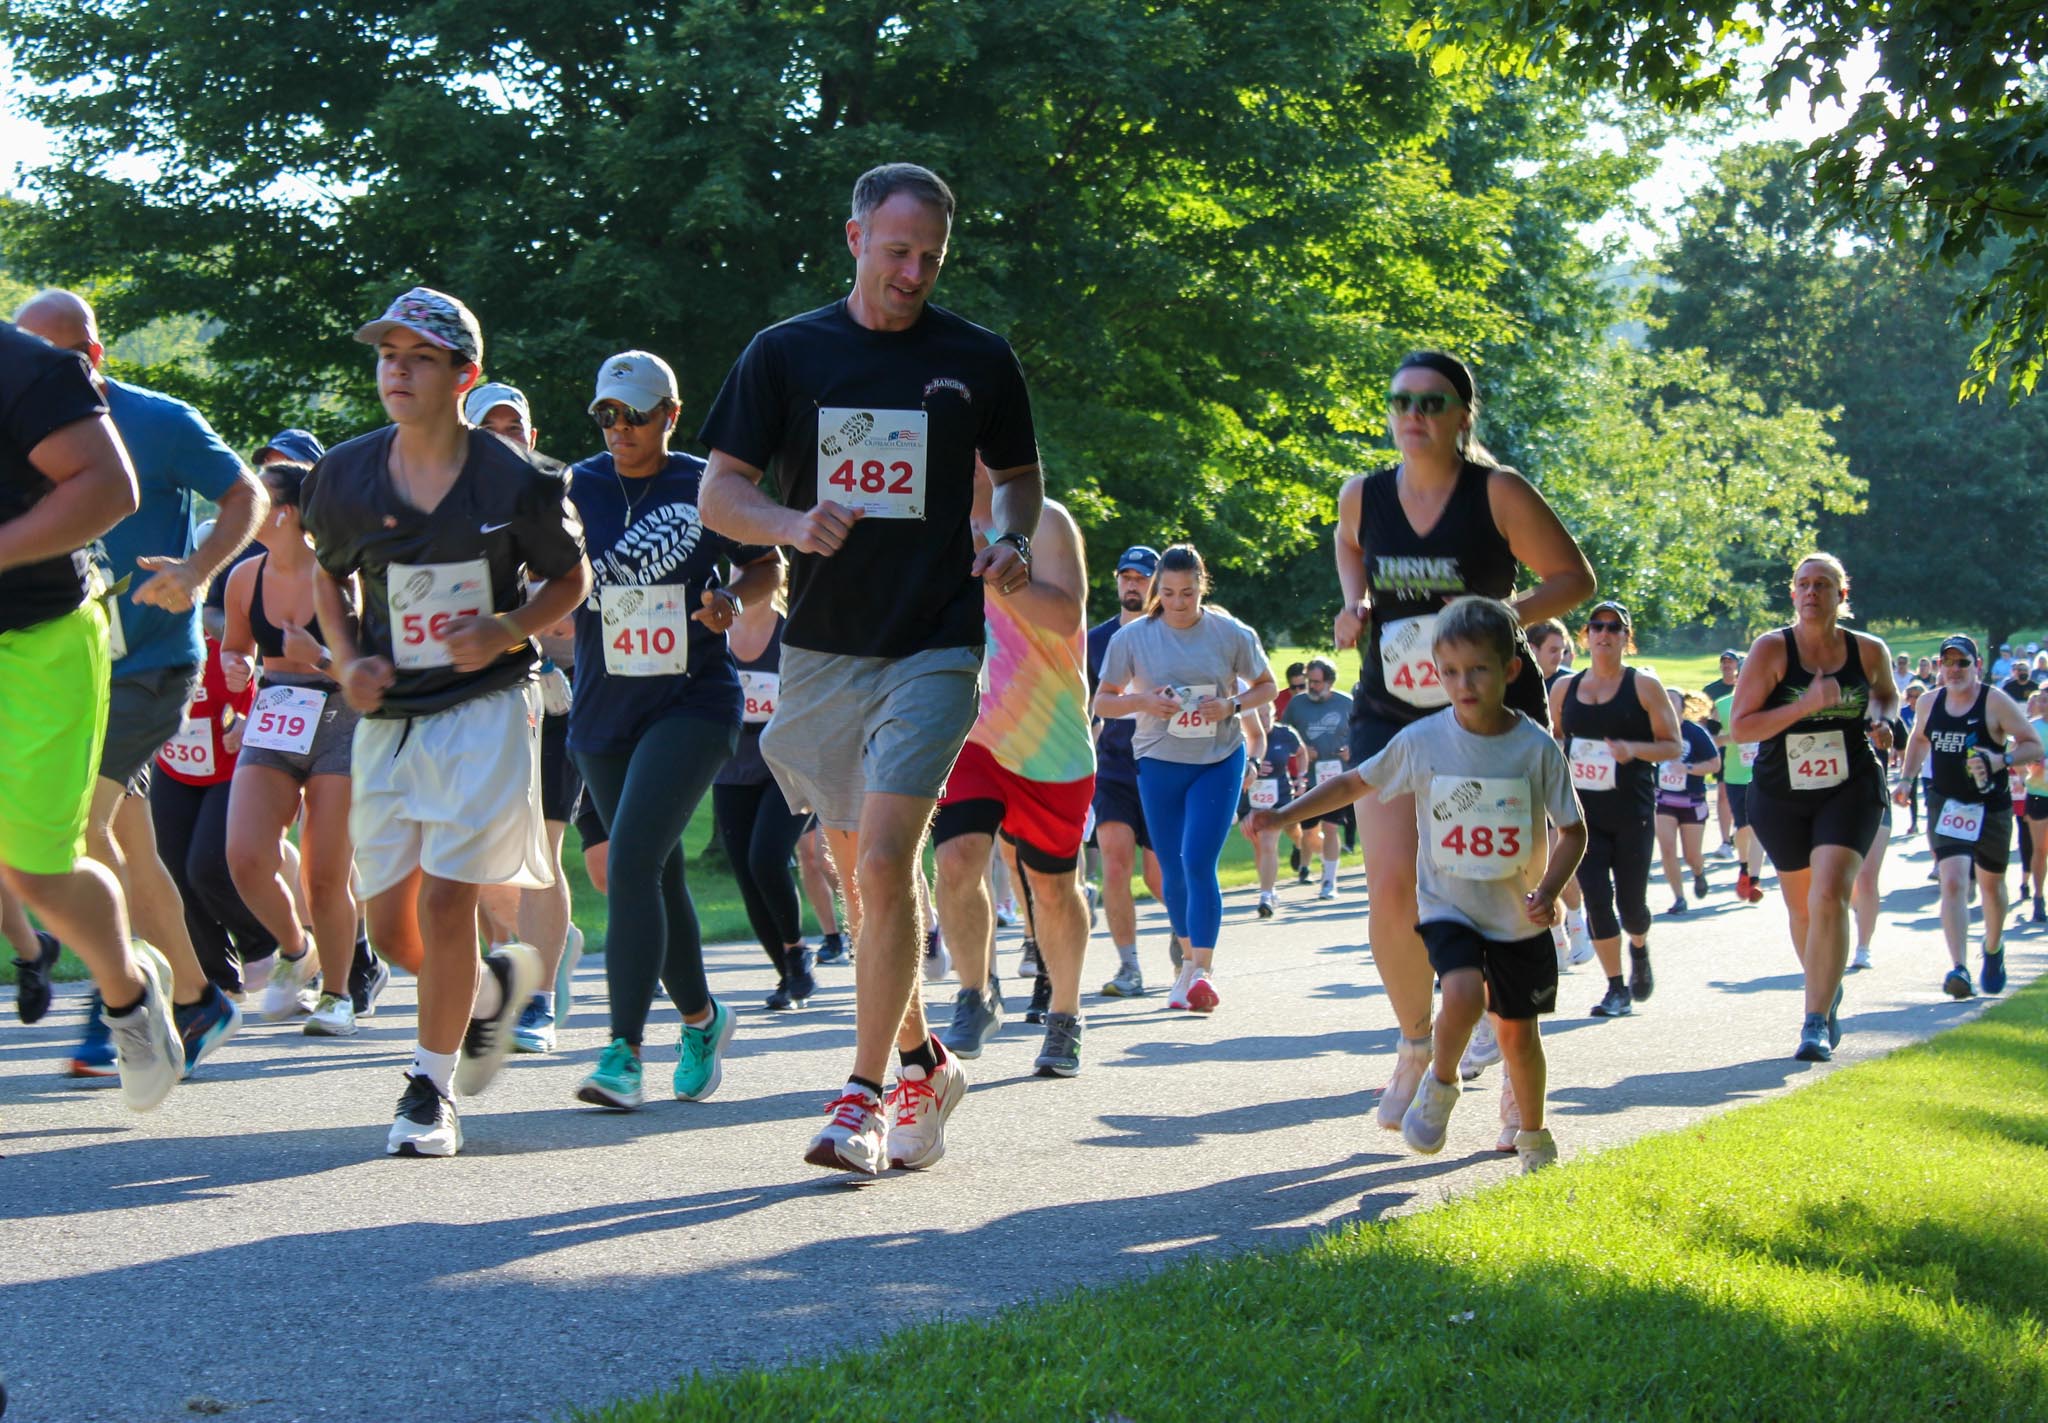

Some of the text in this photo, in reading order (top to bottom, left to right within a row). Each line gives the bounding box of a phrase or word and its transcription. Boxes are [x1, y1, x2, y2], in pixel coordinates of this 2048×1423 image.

[829, 459, 913, 494] 482
[615, 504, 675, 557] POUND
[638, 523, 703, 585] GROUND
[1376, 556, 1460, 579] THRIVE
[402, 608, 480, 646] 56
[613, 627, 675, 655] 410
[1393, 660, 1440, 689] 42
[746, 698, 775, 714] 84
[257, 712, 306, 737] 519
[1177, 711, 1209, 727] 46
[1931, 731, 1967, 743] FLEET
[1935, 742, 1965, 753] FEET
[163, 742, 207, 763] 630
[1574, 763, 1609, 780] 387
[1798, 758, 1838, 777] 421
[1942, 815, 1977, 831] 600
[1441, 824, 1520, 857] 483
